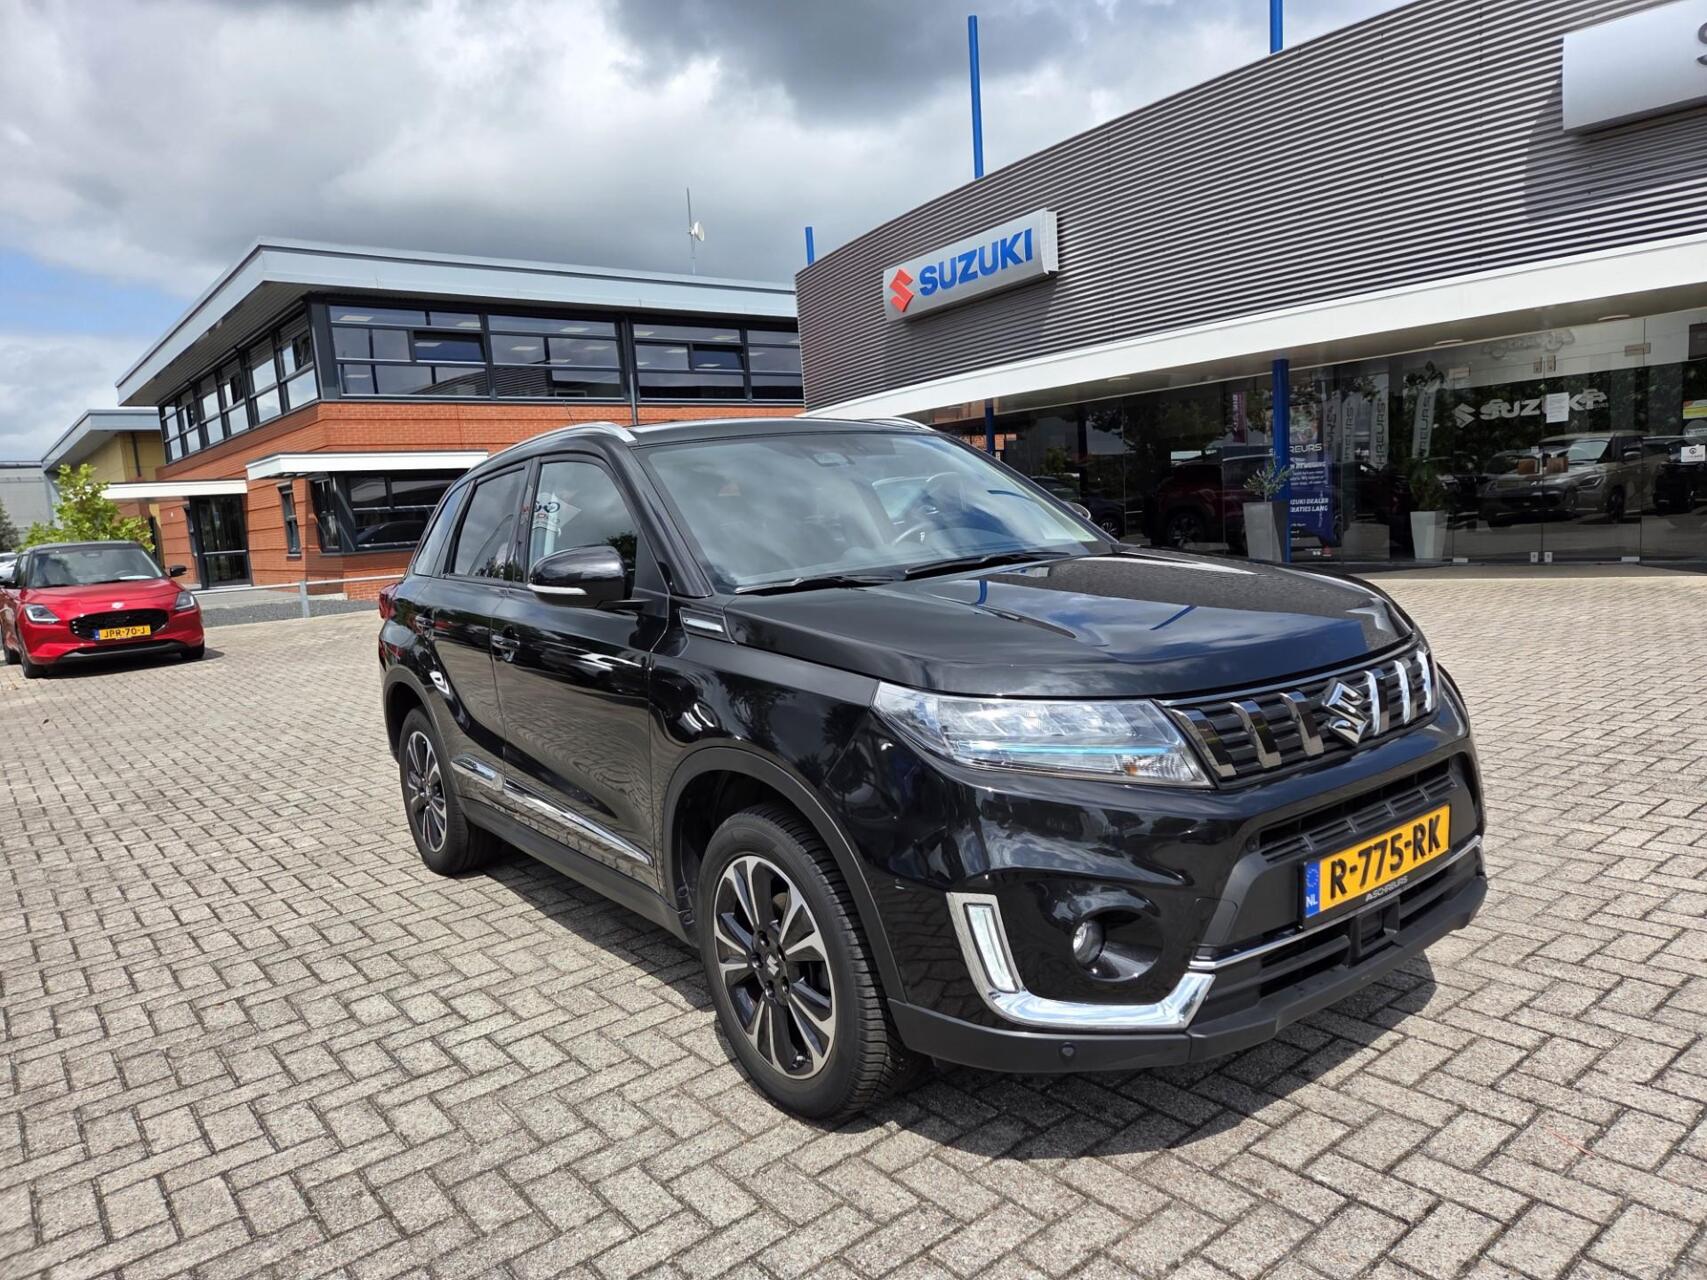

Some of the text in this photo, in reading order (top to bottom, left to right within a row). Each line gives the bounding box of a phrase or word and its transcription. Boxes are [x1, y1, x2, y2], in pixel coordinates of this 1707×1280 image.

[919, 228, 1033, 296] SUZUKI
[1330, 814, 1441, 900] R-775-RK
[1305, 893, 1318, 907] NL
